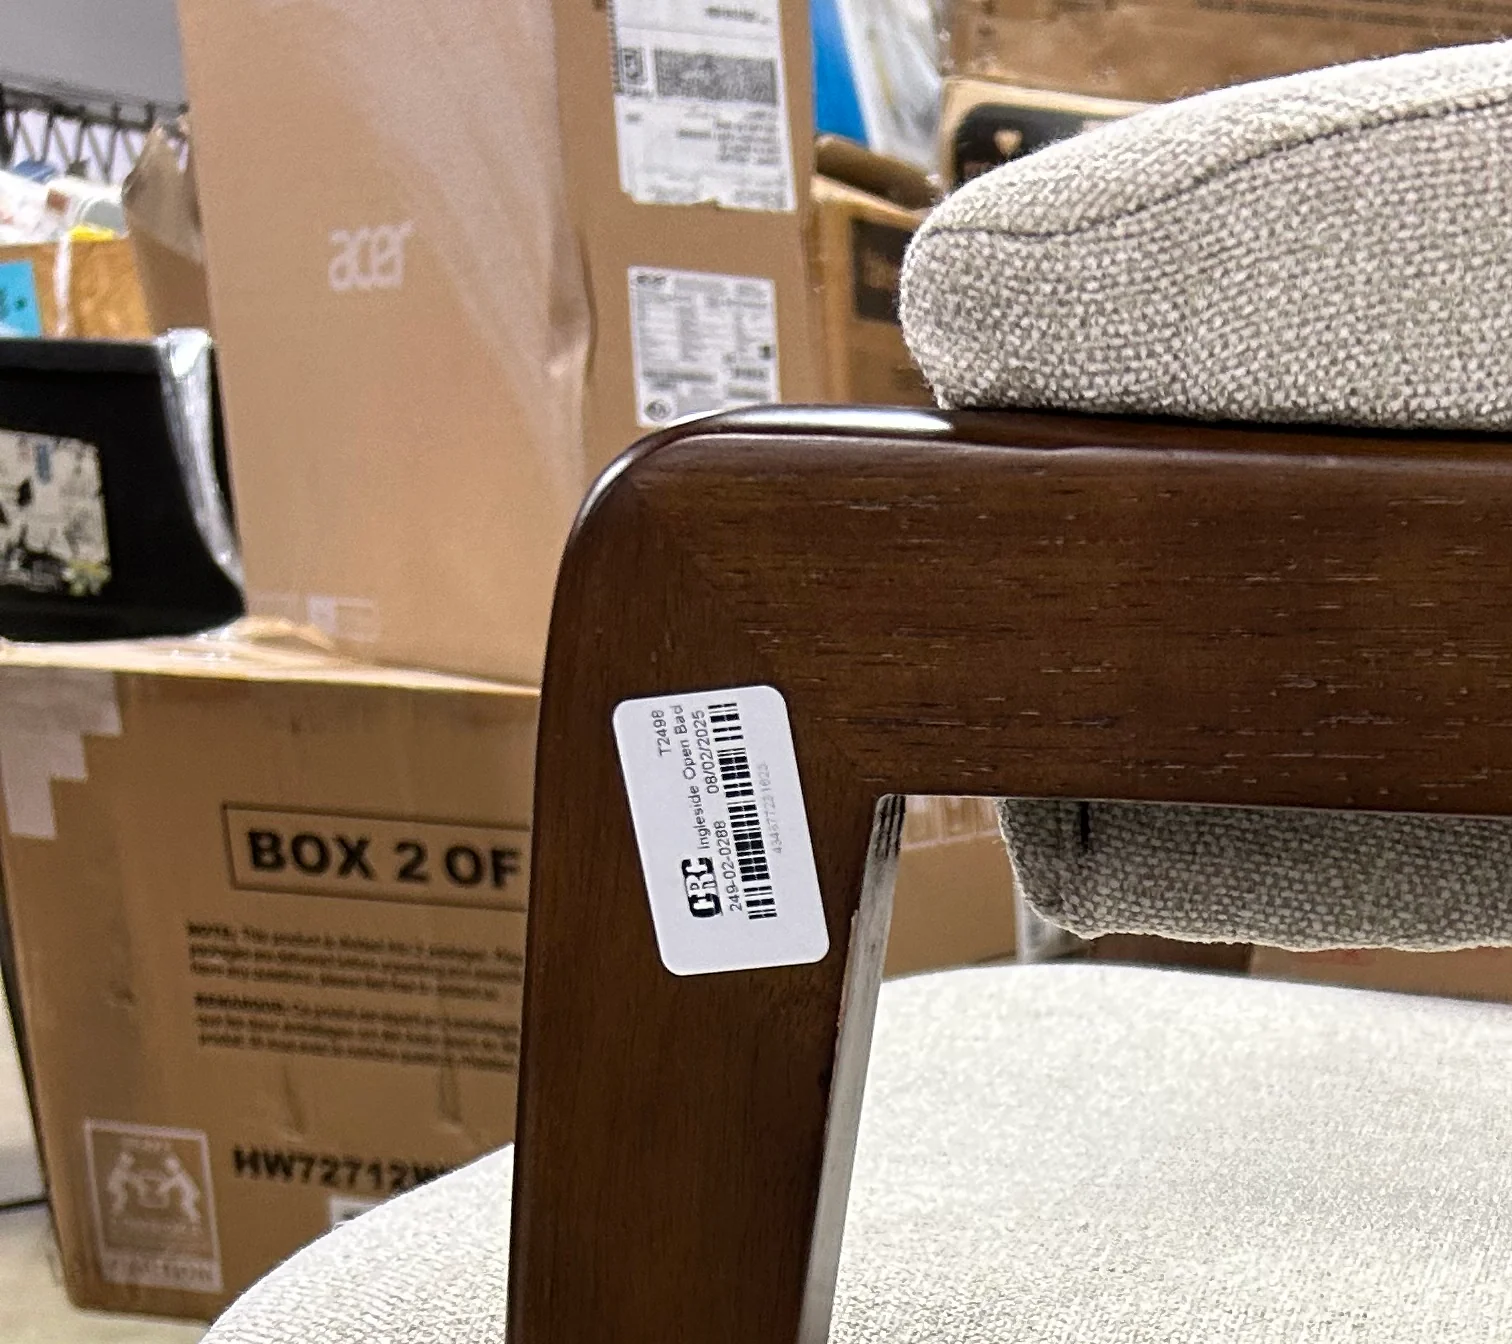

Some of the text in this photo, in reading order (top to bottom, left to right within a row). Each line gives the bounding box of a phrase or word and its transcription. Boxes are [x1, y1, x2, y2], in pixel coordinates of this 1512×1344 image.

[328, 222, 415, 291] acer
[651, 709, 671, 756] T2498
[680, 739, 698, 780] Open
[687, 784, 712, 850] Ingleside
[691, 709, 743, 912] 249-02-0288 08/02/2025
[248, 829, 521, 889] BOX 2 OF
